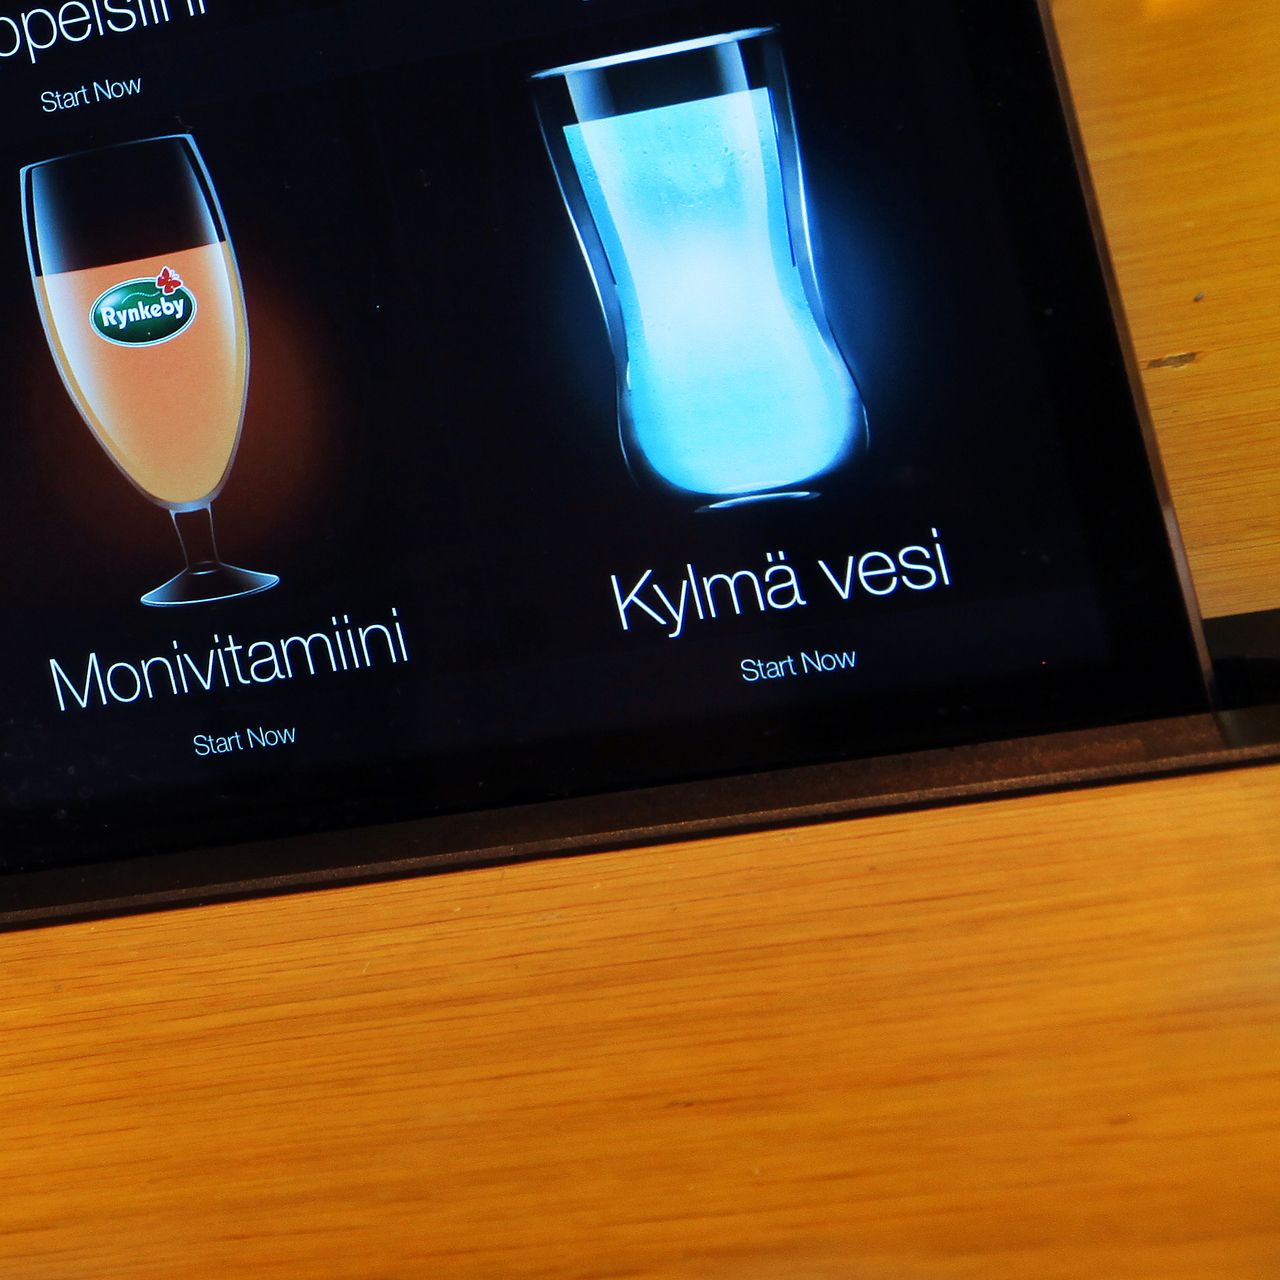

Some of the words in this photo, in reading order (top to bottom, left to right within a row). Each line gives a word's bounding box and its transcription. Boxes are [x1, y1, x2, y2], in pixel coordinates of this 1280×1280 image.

[40, 85, 91, 113] Start
[93, 77, 142, 102] Now
[99, 296, 185, 330] Rynkeby
[610, 550, 808, 639] Kylmä
[817, 527, 953, 601] vesi
[48, 607, 410, 712] Monivitamiini
[740, 655, 798, 682] Start
[800, 649, 856, 674] Now
[192, 730, 244, 756] Start
[246, 725, 297, 749] Now
